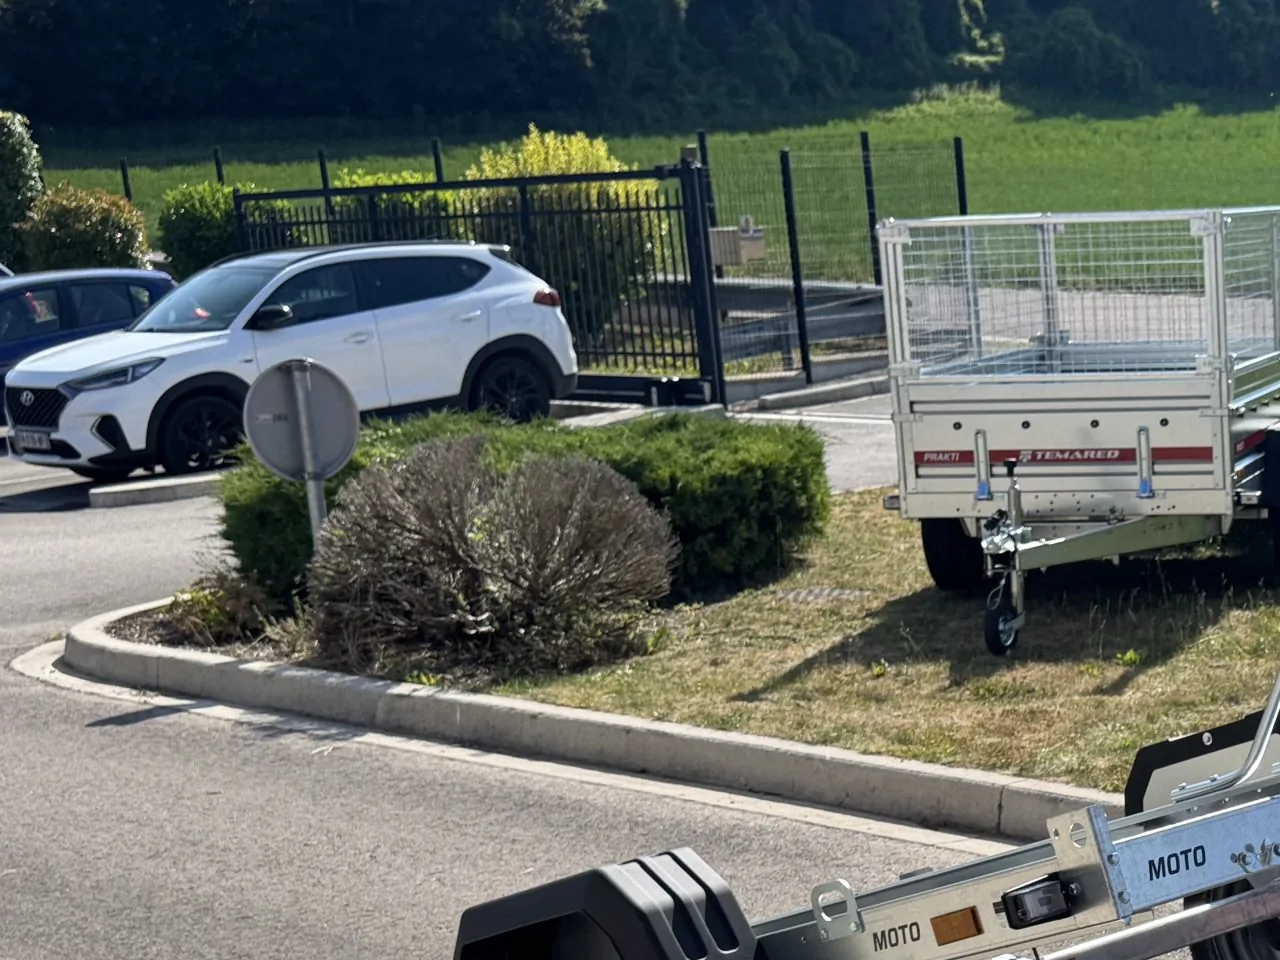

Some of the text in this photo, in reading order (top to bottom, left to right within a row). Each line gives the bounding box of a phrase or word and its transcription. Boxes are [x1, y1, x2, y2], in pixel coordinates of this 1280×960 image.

[923, 452, 960, 462] PRAKTI
[1035, 449, 1120, 460] TEMARED
[1147, 844, 1206, 881] MOTO
[872, 921, 921, 952] MOTO
